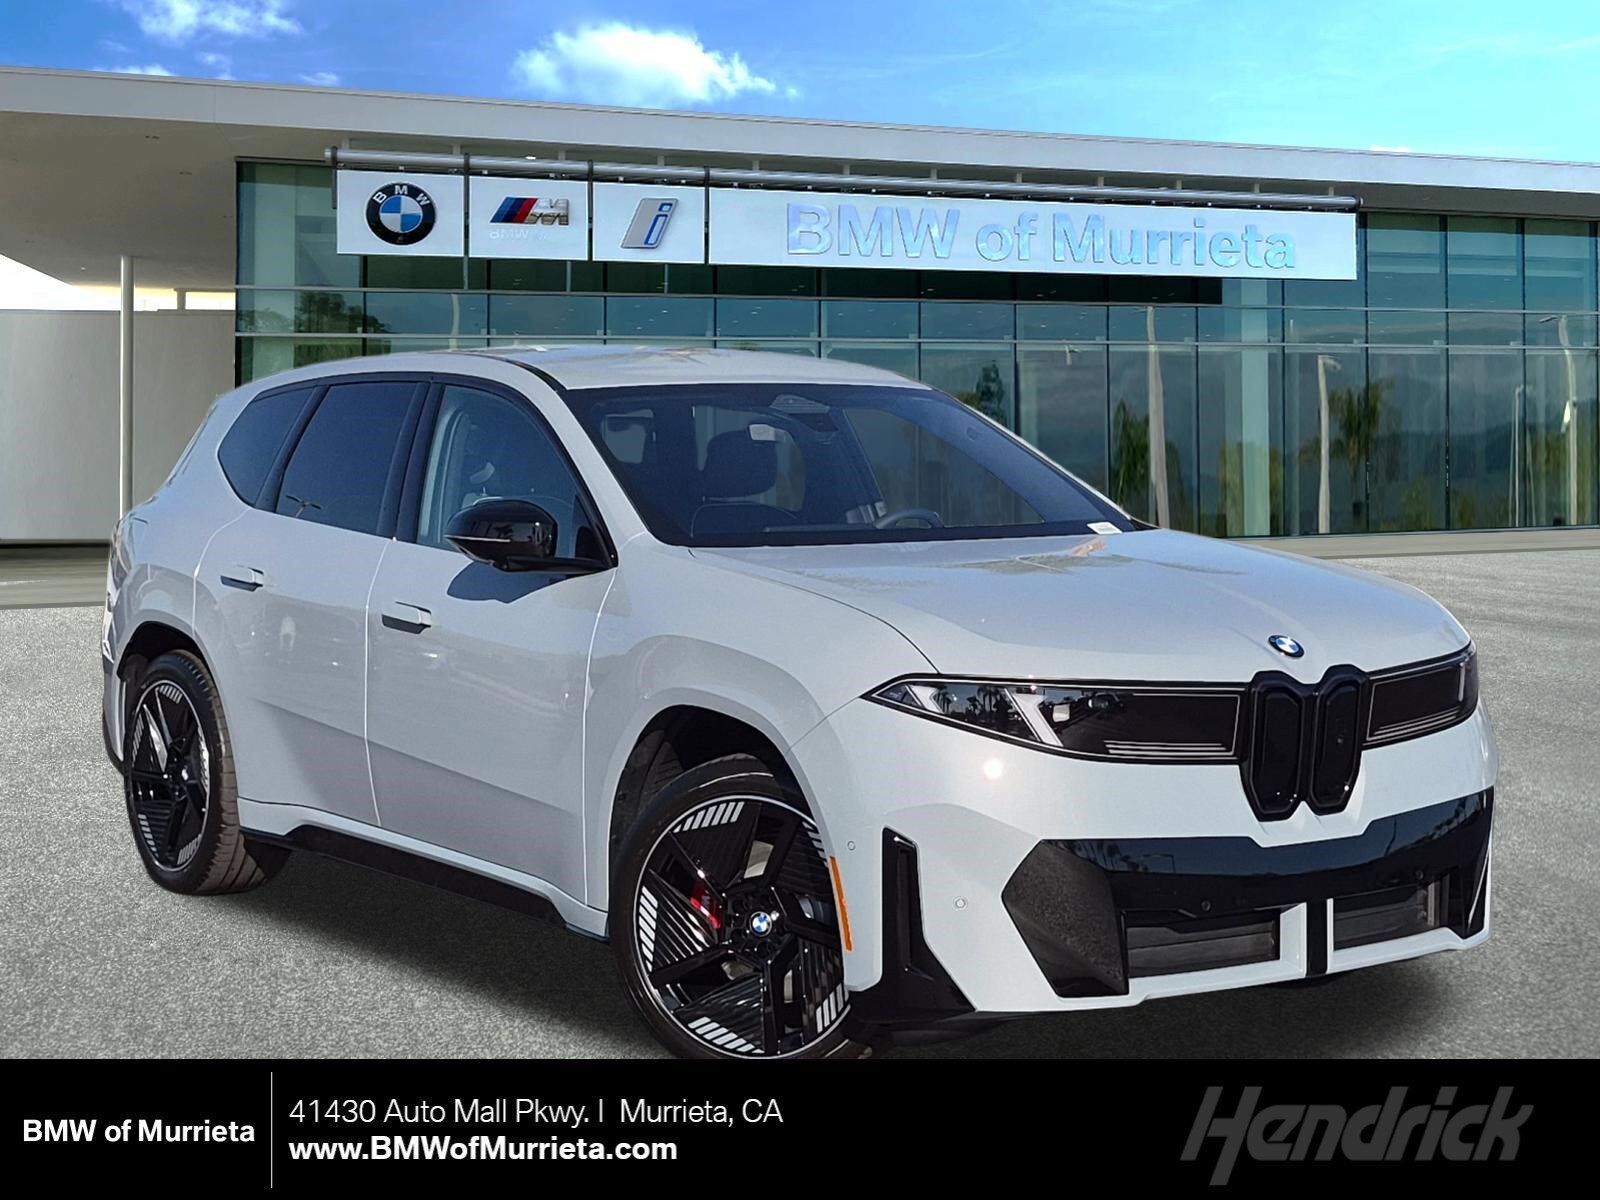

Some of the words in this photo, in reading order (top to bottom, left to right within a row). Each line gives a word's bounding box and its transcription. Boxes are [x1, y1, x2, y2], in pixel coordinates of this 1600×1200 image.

[372, 185, 431, 206] BMW
[785, 202, 961, 259] BMW
[974, 212, 1038, 262] of
[1052, 211, 1297, 269] Murrieta
